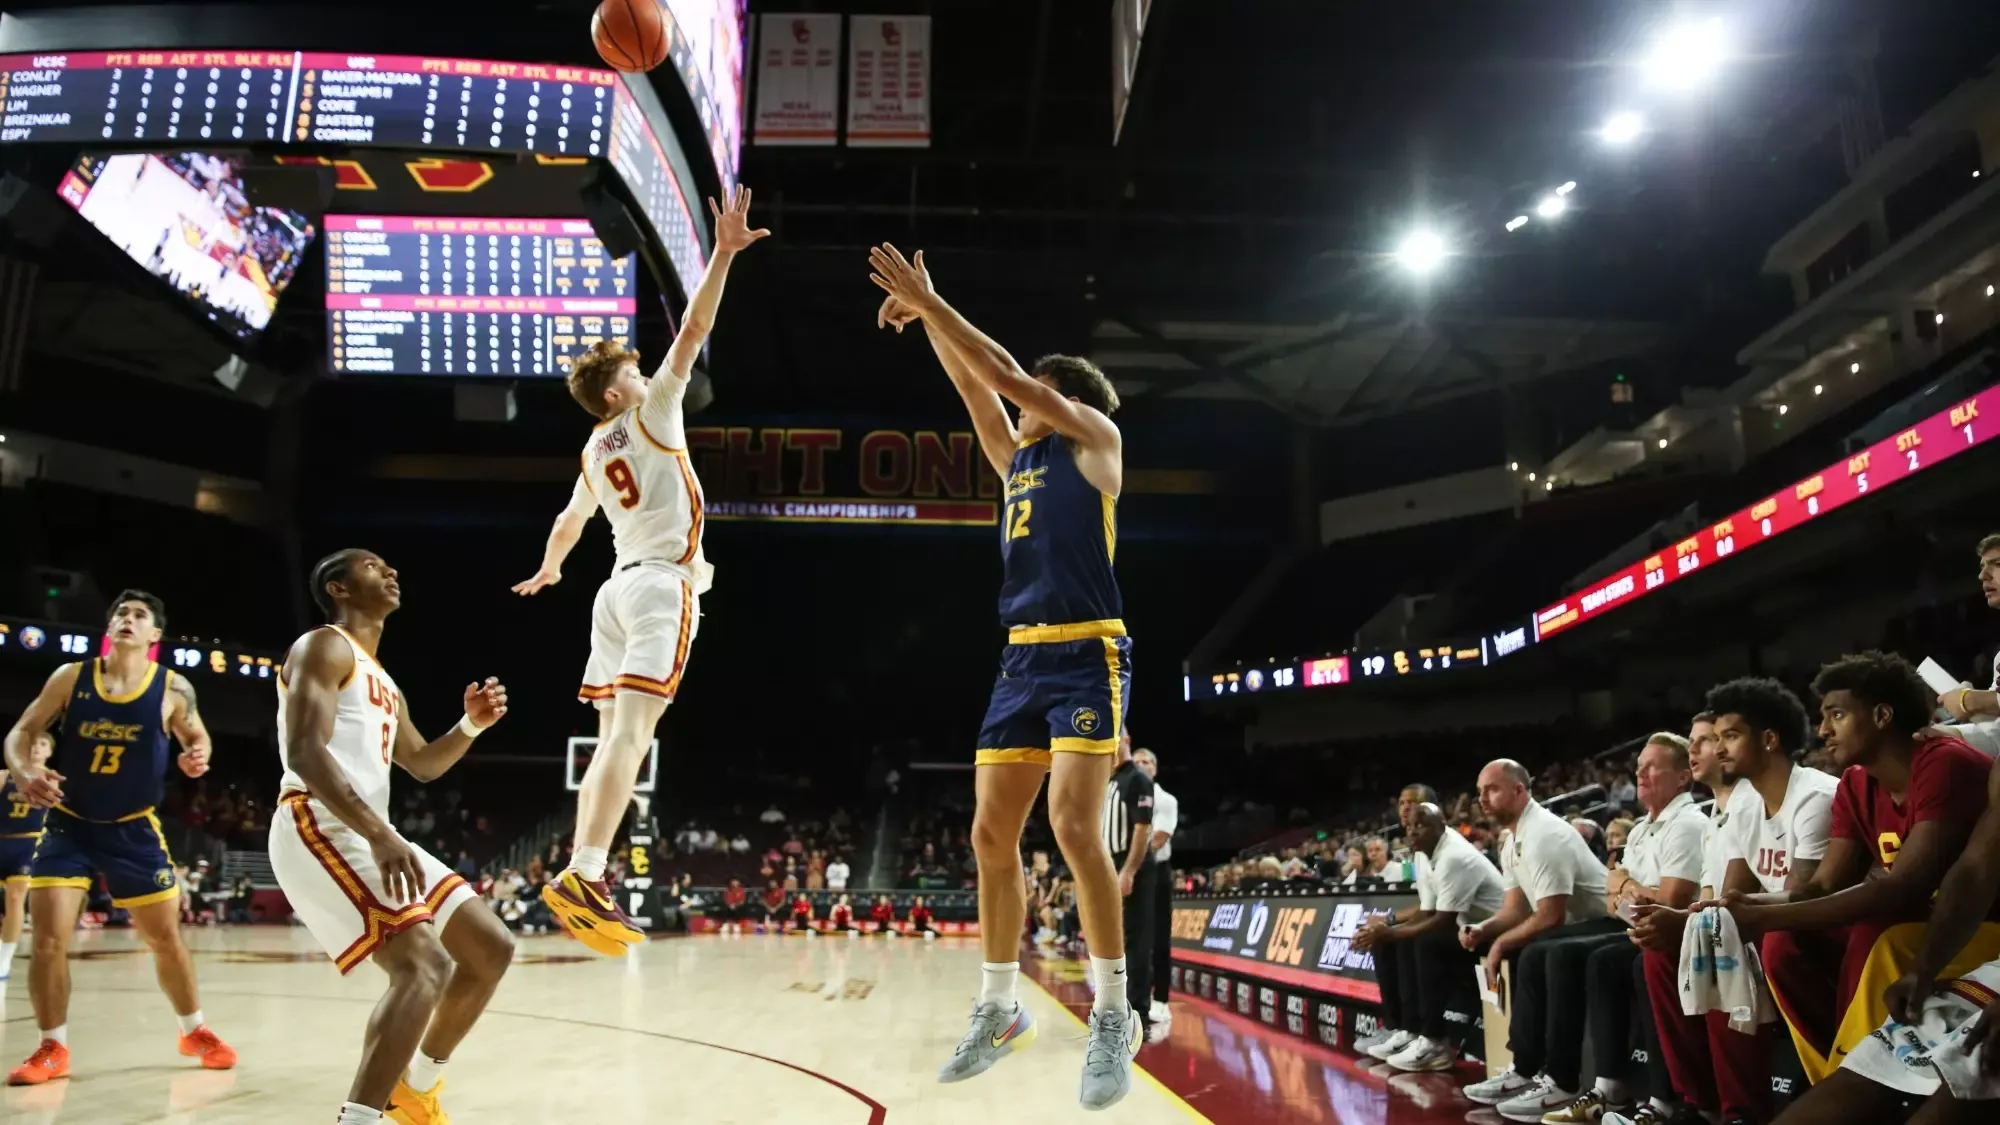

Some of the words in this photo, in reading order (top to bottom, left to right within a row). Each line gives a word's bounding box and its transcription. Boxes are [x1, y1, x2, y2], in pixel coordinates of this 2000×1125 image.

[12, 71, 62, 83] CONLEY
[532, 80, 541, 93] 1
[10, 85, 63, 97] WAGNER
[320, 85, 383, 98] WILLIAMS
[594, 100, 603, 114] 1
[141, 96, 149, 109] 1
[270, 97, 279, 110] 1
[460, 104, 469, 117] 1
[560, 112, 569, 125] 1
[4, 113, 71, 126] BREZNIKAR
[205, 111, 213, 124] 1
[236, 112, 245, 124] 1
[266, 126, 275, 139] 1
[457, 133, 465, 146] 1
[526, 138, 534, 150] 1
[558, 140, 566, 153] 1
[1950, 398, 1979, 428] BLK
[1896, 429, 1922, 452] STL
[1963, 424, 1974, 444] 1
[1848, 452, 1870, 476] AST
[1906, 450, 1920, 470] 2
[605, 458, 640, 510] 9
[1856, 472, 1868, 493] 5
[784, 502, 918, 519] CHAMPIONSHIPS
[1006, 498, 1032, 544] 12
[1581, 588, 1606, 613] TEAM
[60, 634, 89, 654] 15
[173, 648, 202, 667] 19
[1272, 668, 1294, 687] 15
[1361, 656, 1385, 676] 19
[89, 744, 126, 774] 13
[1756, 848, 1788, 879] US
[1266, 908, 1317, 966] USC
[1318, 1002, 1337, 1026] ARCO
[1355, 1013, 1377, 1036] ARCO
